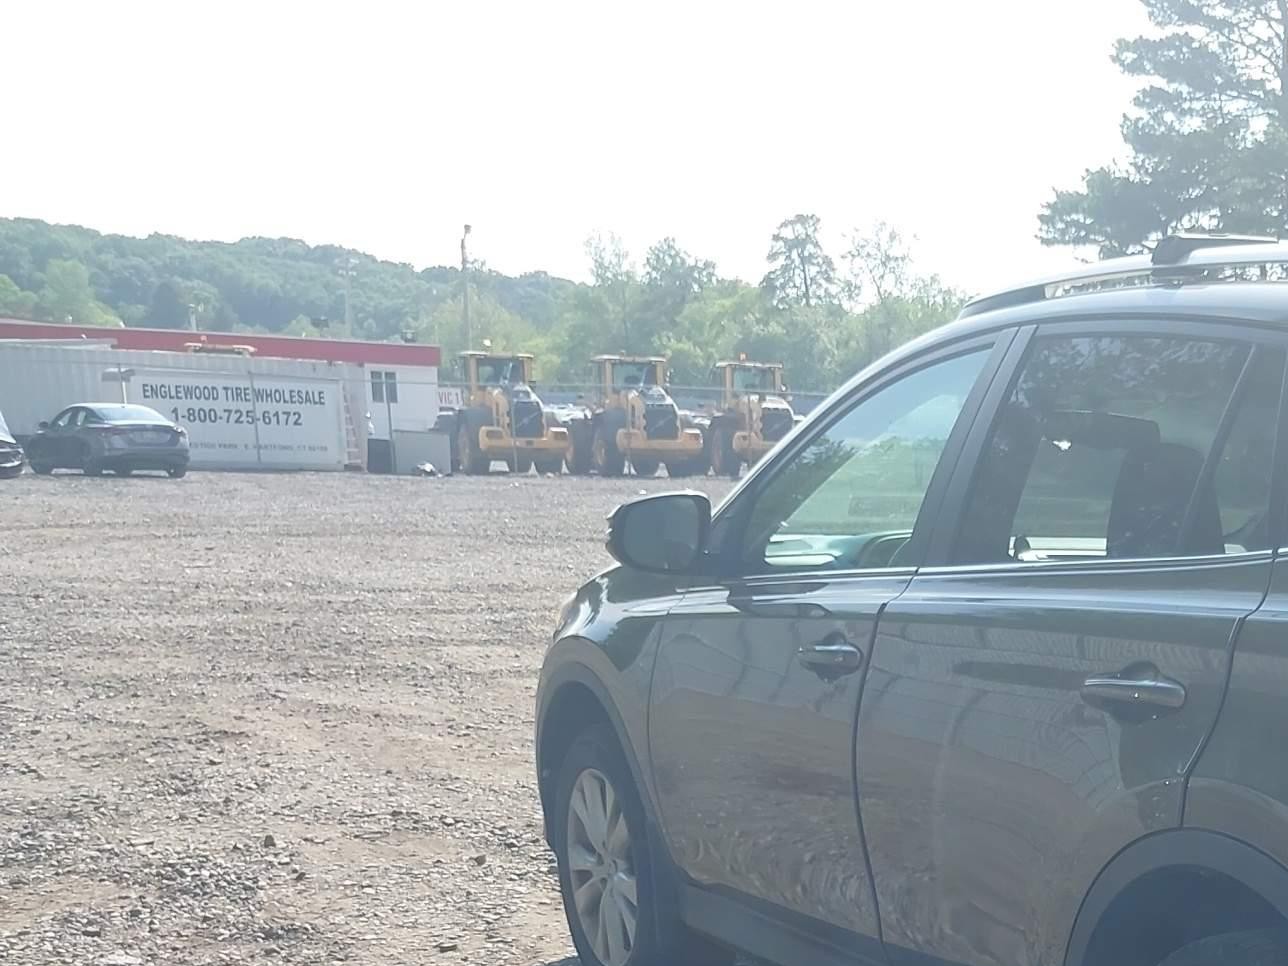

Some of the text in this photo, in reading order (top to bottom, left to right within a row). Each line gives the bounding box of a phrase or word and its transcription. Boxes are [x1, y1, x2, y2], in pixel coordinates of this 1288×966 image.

[142, 384, 326, 405] ENGLEWOOD TIRE WHOLESALE
[171, 407, 303, 426] 1-800-725-6172
